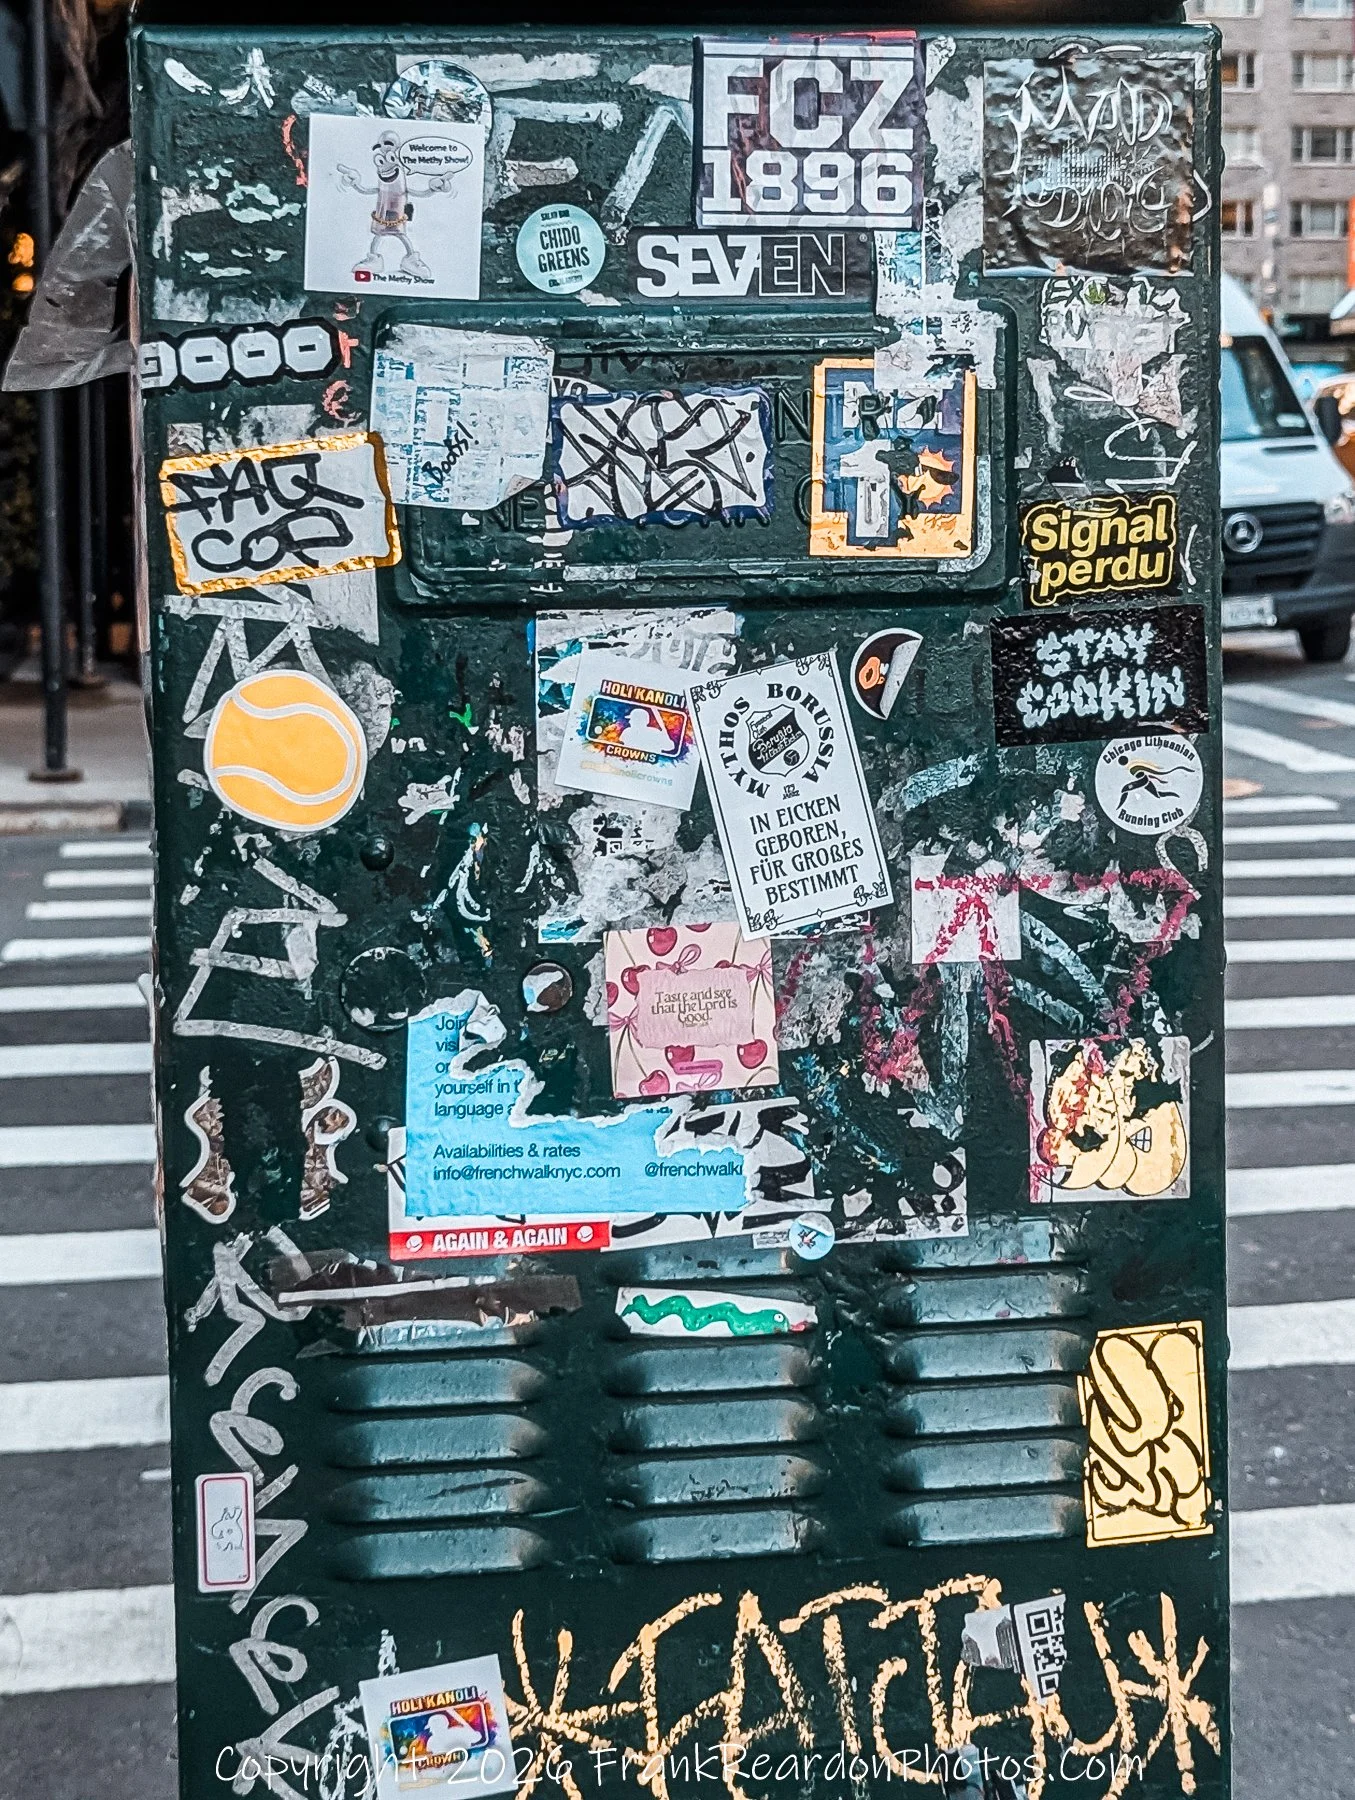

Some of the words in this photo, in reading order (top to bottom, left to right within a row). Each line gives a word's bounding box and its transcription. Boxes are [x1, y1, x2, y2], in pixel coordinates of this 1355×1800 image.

[703, 57, 914, 151] FCZ
[403, 156, 417, 165] The
[418, 156, 443, 166] Methy
[444, 155, 469, 165] Show!
[409, 143, 448, 152] Welcome
[449, 143, 458, 152] to
[702, 149, 914, 214] 1896
[539, 225, 581, 250] CHIDO
[538, 246, 590, 273] GREENS
[373, 273, 387, 282] The
[388, 274, 412, 285] Methy
[413, 275, 436, 285] Show
[1030, 504, 1168, 558] Signal
[1039, 547, 1165, 598] perdu
[1035, 621, 1155, 678] STAY
[600, 679, 635, 698] HOLI
[1015, 665, 1185, 729] COOKIN
[605, 744, 657, 763] CROWNS
[718, 696, 770, 799] MYTHOS
[767, 683, 834, 783] BORUSSIA
[1102, 738, 1142, 764] Chicago
[1144, 735, 1196, 762] Lithuanian
[749, 812, 772, 835] IN
[778, 793, 841, 830] EICKEN
[1118, 808, 1160, 828] Running
[1161, 806, 1184, 824] Club
[755, 819, 847, 858] GEBOREN,
[750, 857, 787, 885] FÜR
[765, 863, 859, 906] BESTIMMT
[651, 1002, 675, 1015] that
[678, 1002, 697, 1014] the
[698, 998, 726, 1011] Lord
[728, 998, 738, 1009] is
[655, 990, 688, 1004] Taste
[690, 987, 712, 1001] and
[713, 988, 732, 999] see
[677, 1011, 713, 1024] Good.
[435, 1079, 494, 1099] yourself
[497, 1079, 510, 1094] in
[435, 1101, 504, 1120] language
[433, 1143, 524, 1160] Availabilities
[527, 1144, 540, 1158] &
[543, 1144, 582, 1158] rates
[433, 1163, 621, 1183] info@frenchwalknyc.com
[432, 1230, 489, 1253] AGAIN
[493, 1228, 510, 1249] &
[512, 1226, 568, 1248] AGAIN
